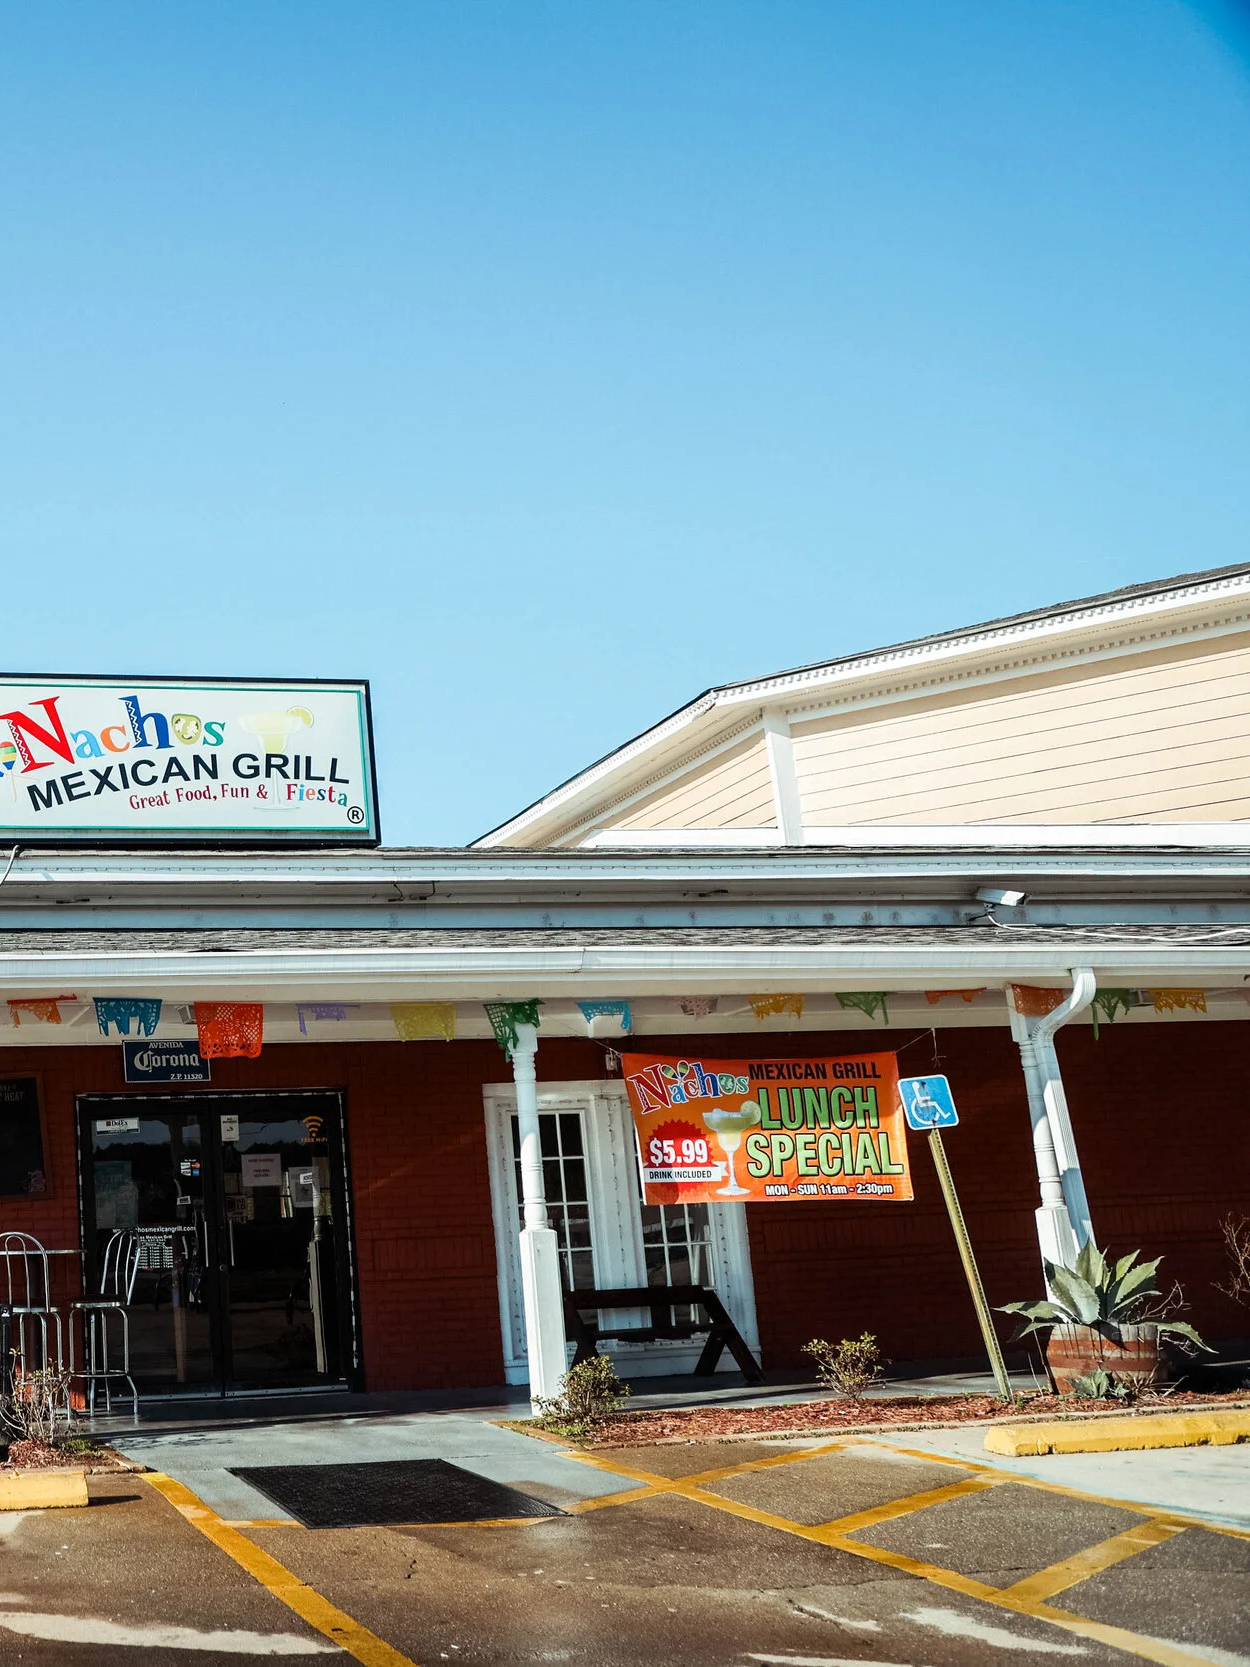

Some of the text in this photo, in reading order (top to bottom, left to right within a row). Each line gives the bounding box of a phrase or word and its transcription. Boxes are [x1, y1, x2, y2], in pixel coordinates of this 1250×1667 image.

[27, 753, 350, 811] MEXICAN GRILL
[129, 783, 348, 811] Great Food, Fun & Fiesta
[149, 1041, 184, 1049] AVENIDA
[134, 1051, 200, 1073] Corona
[748, 1062, 881, 1081] MEXICAN GRILL
[5, 1091, 25, 1102] HEAT
[627, 1061, 750, 1115] Nachos
[757, 1086, 881, 1131] LUNCH
[649, 1138, 708, 1167] $5.99
[746, 1132, 905, 1178] SPECIAL
[649, 1170, 712, 1180] DRINK INCLUDED
[765, 1184, 790, 1196] MON
[797, 1184, 818, 1196] SUN
[820, 1184, 848, 1195] 11am
[856, 1183, 893, 1196] 2:30pm
